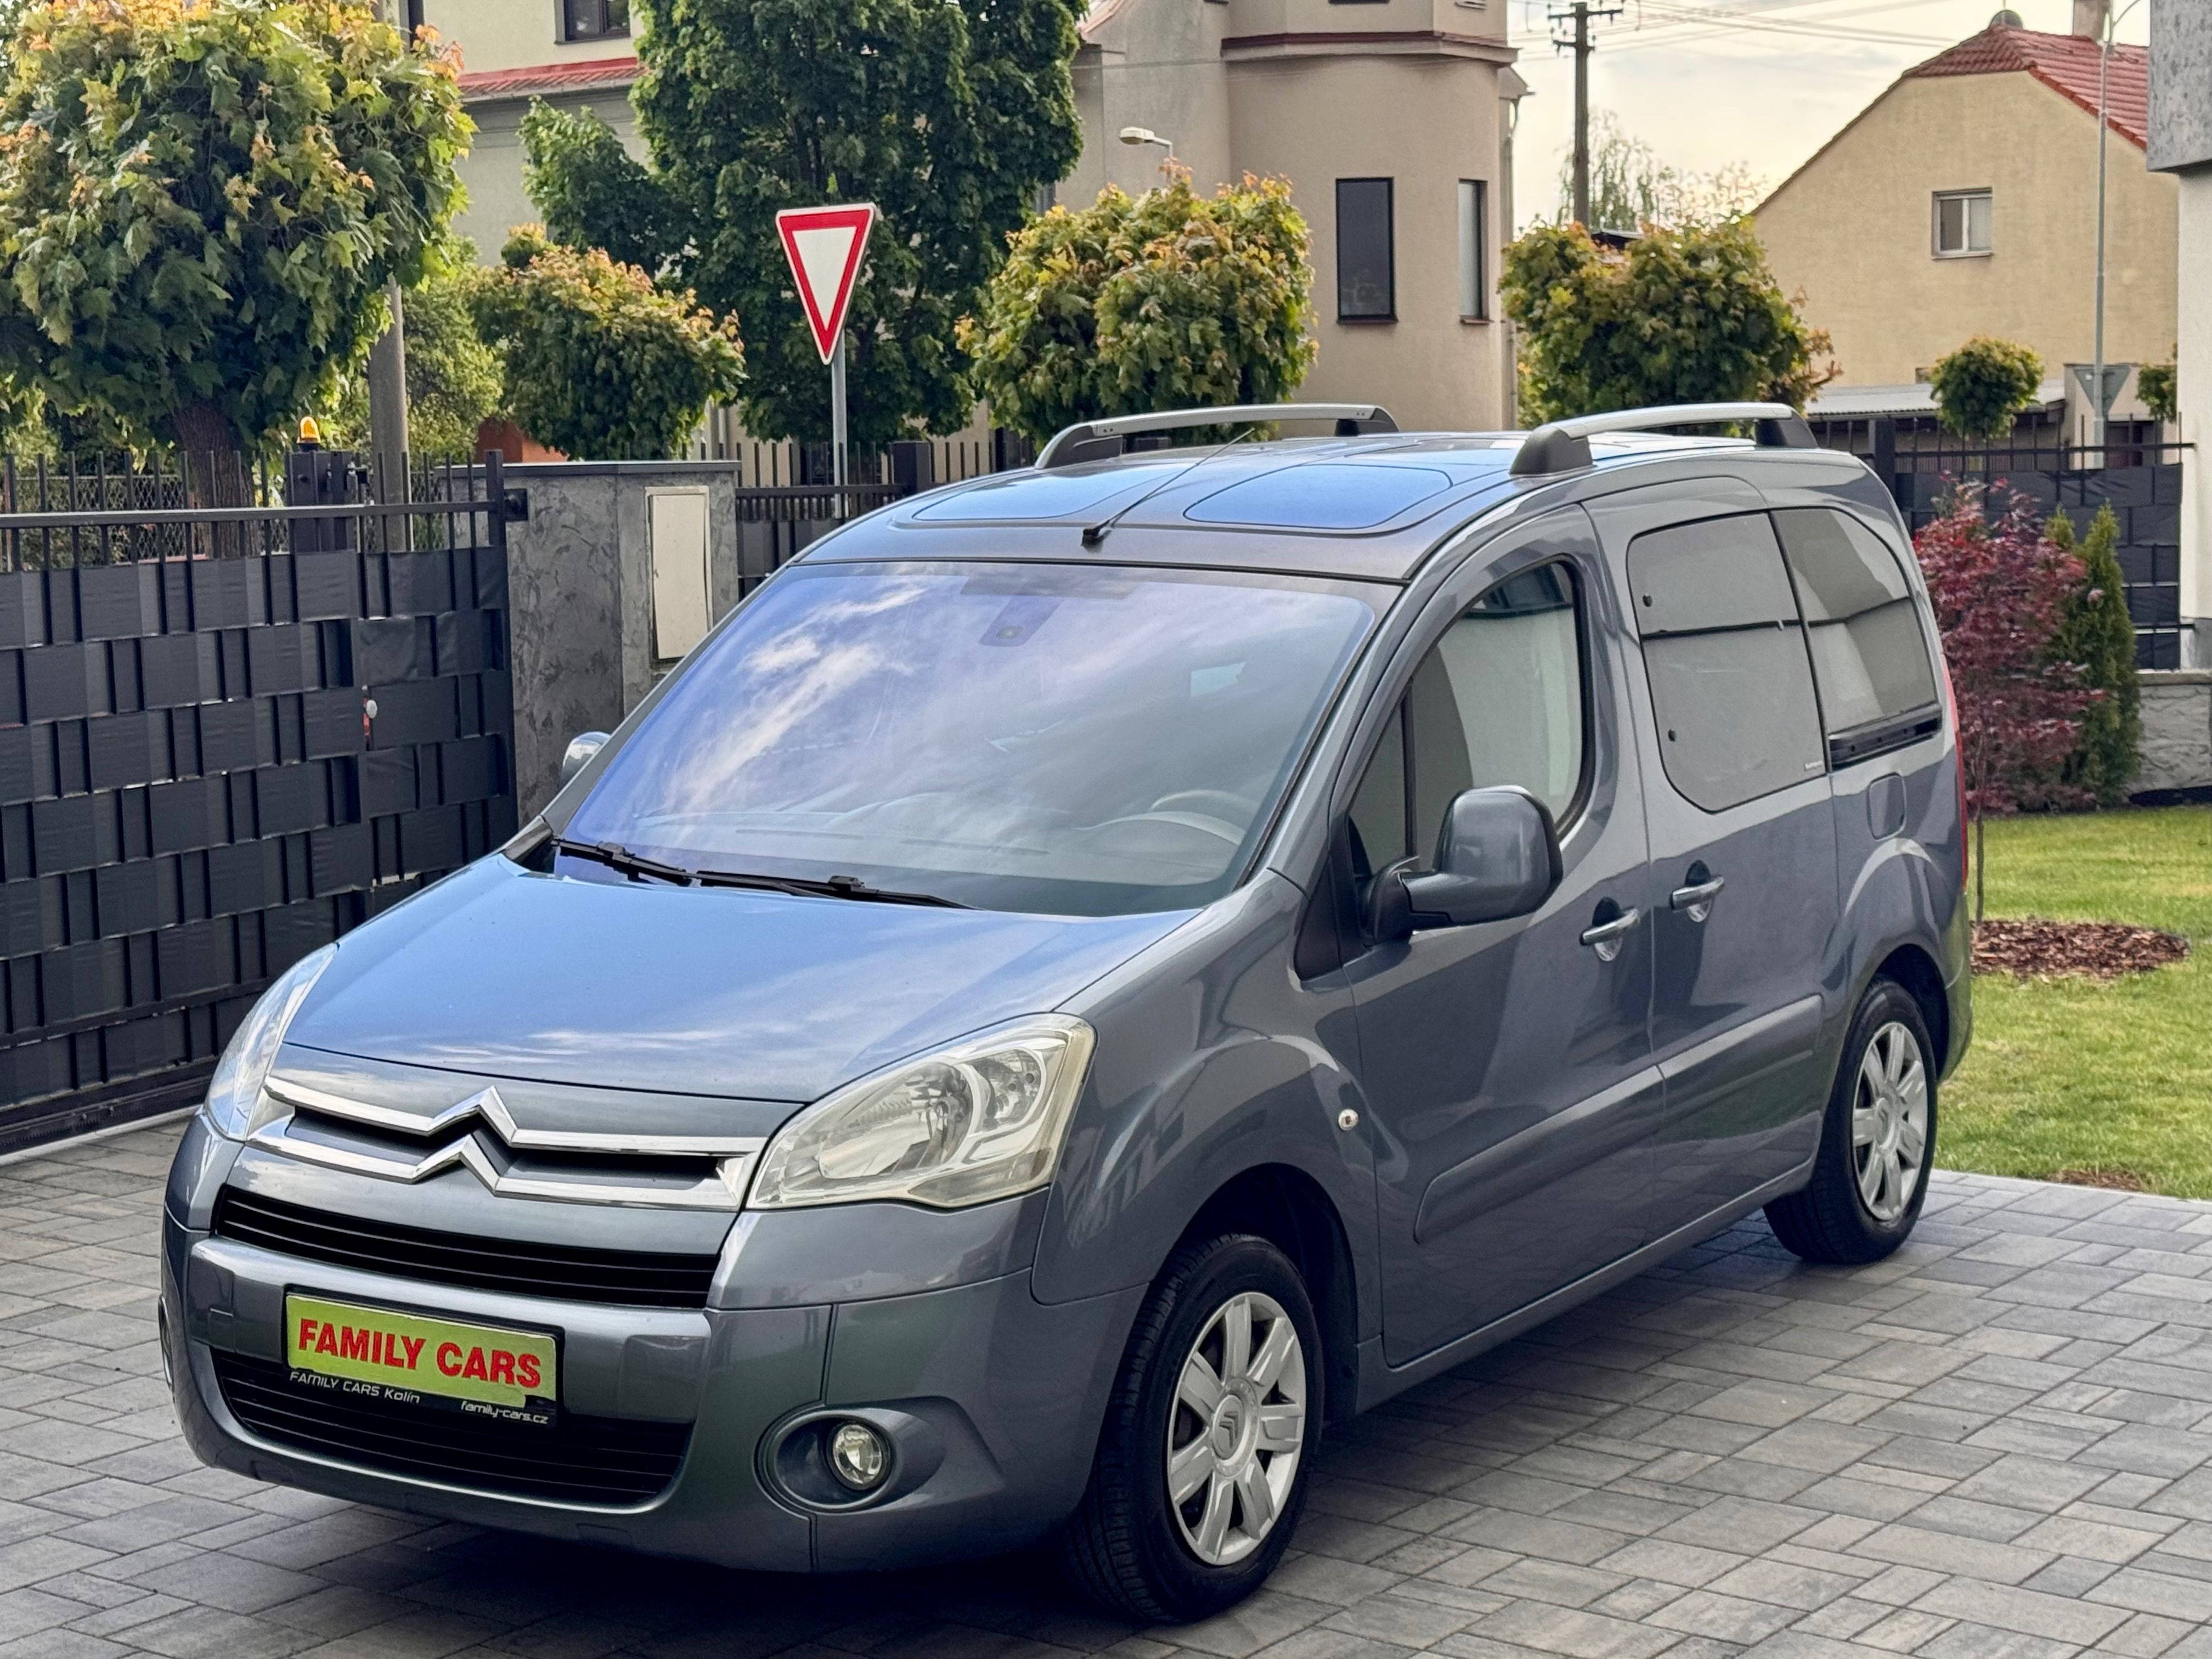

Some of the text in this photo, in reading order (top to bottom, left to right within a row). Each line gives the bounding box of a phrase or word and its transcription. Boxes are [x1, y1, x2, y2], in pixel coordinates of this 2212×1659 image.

[298, 1318, 541, 1389] FAMILY CARS
[289, 1372, 420, 1404] FAMILY CARS Kolín
[460, 1401, 549, 1425] family-cars.cz
